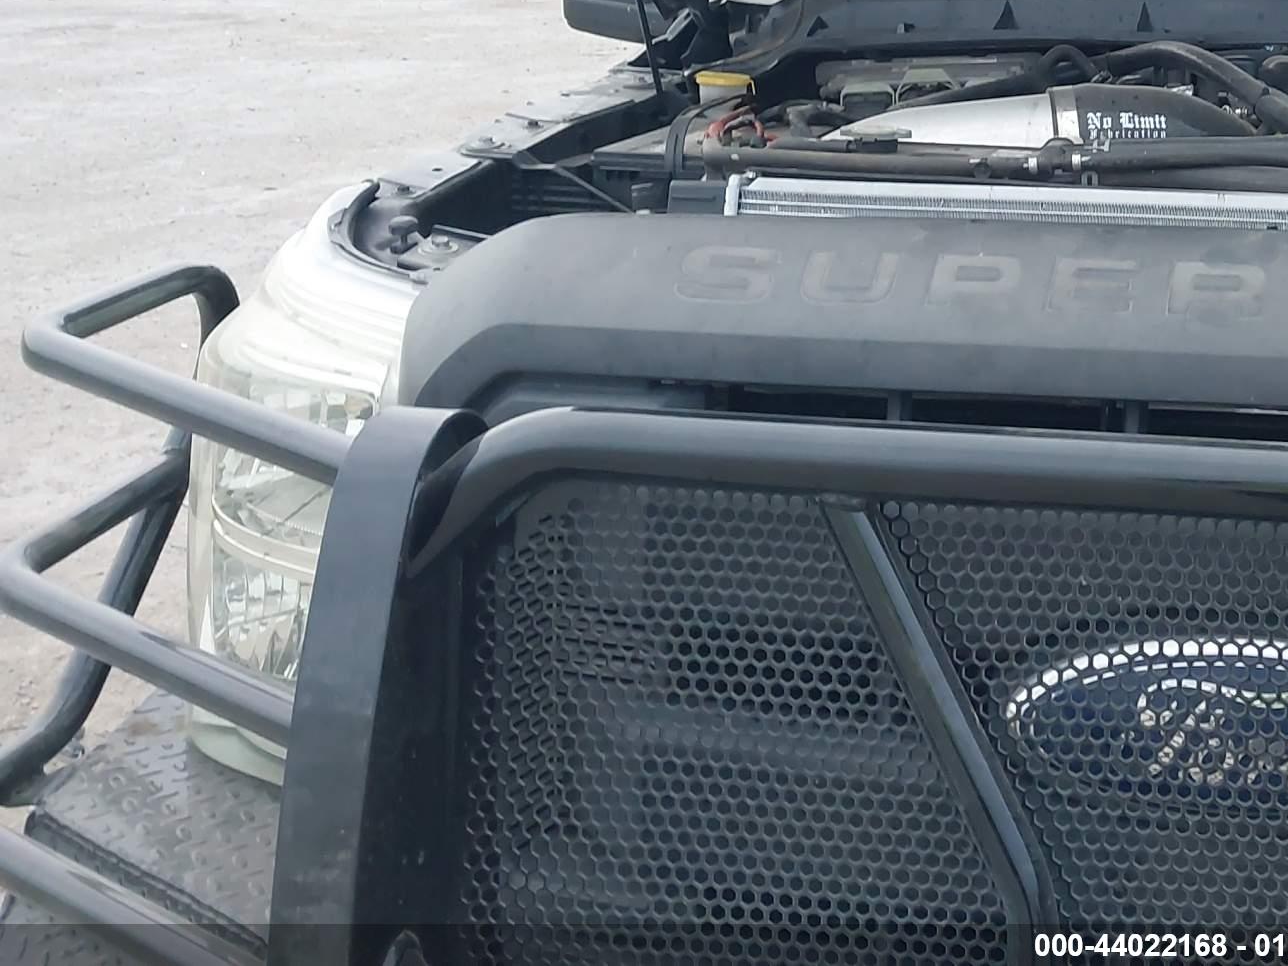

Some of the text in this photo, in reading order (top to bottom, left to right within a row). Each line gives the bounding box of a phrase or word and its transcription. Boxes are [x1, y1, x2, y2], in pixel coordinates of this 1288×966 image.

[1086, 112, 1167, 130] No Limit
[673, 245, 1267, 321] SUPER
